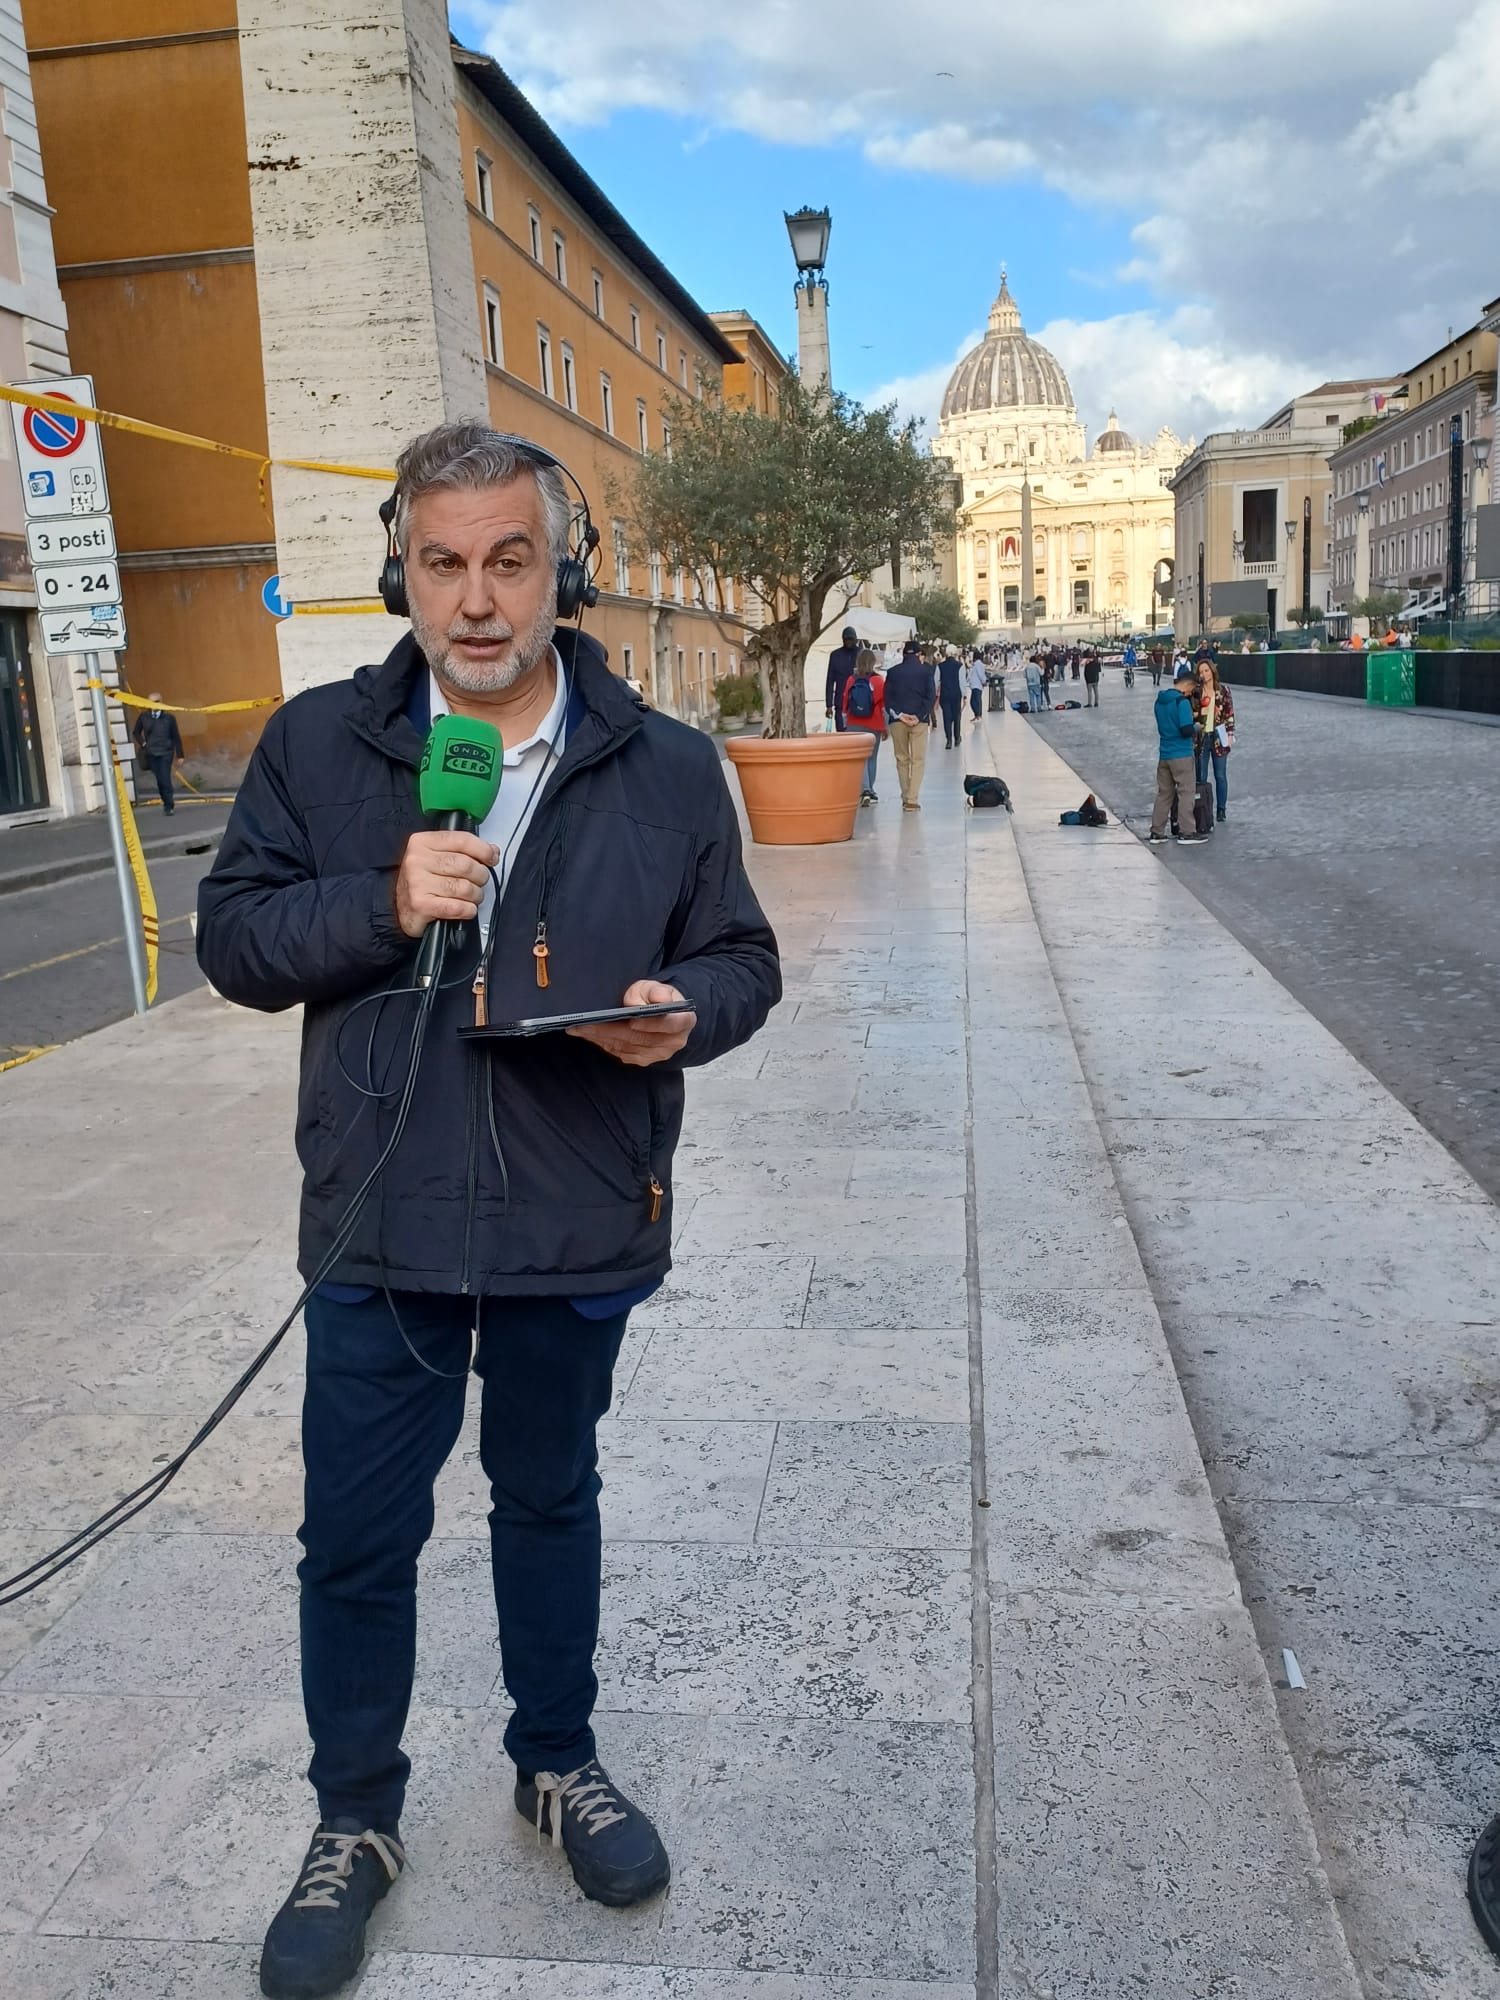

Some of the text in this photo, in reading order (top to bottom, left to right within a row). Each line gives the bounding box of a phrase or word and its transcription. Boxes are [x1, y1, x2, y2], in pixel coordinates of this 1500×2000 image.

[73, 473, 96, 486] C.D.
[37, 529, 106, 552] 3 posti
[80, 574, 110, 592] 24
[453, 745, 488, 758] ONDA
[452, 759, 486, 772] CERO
